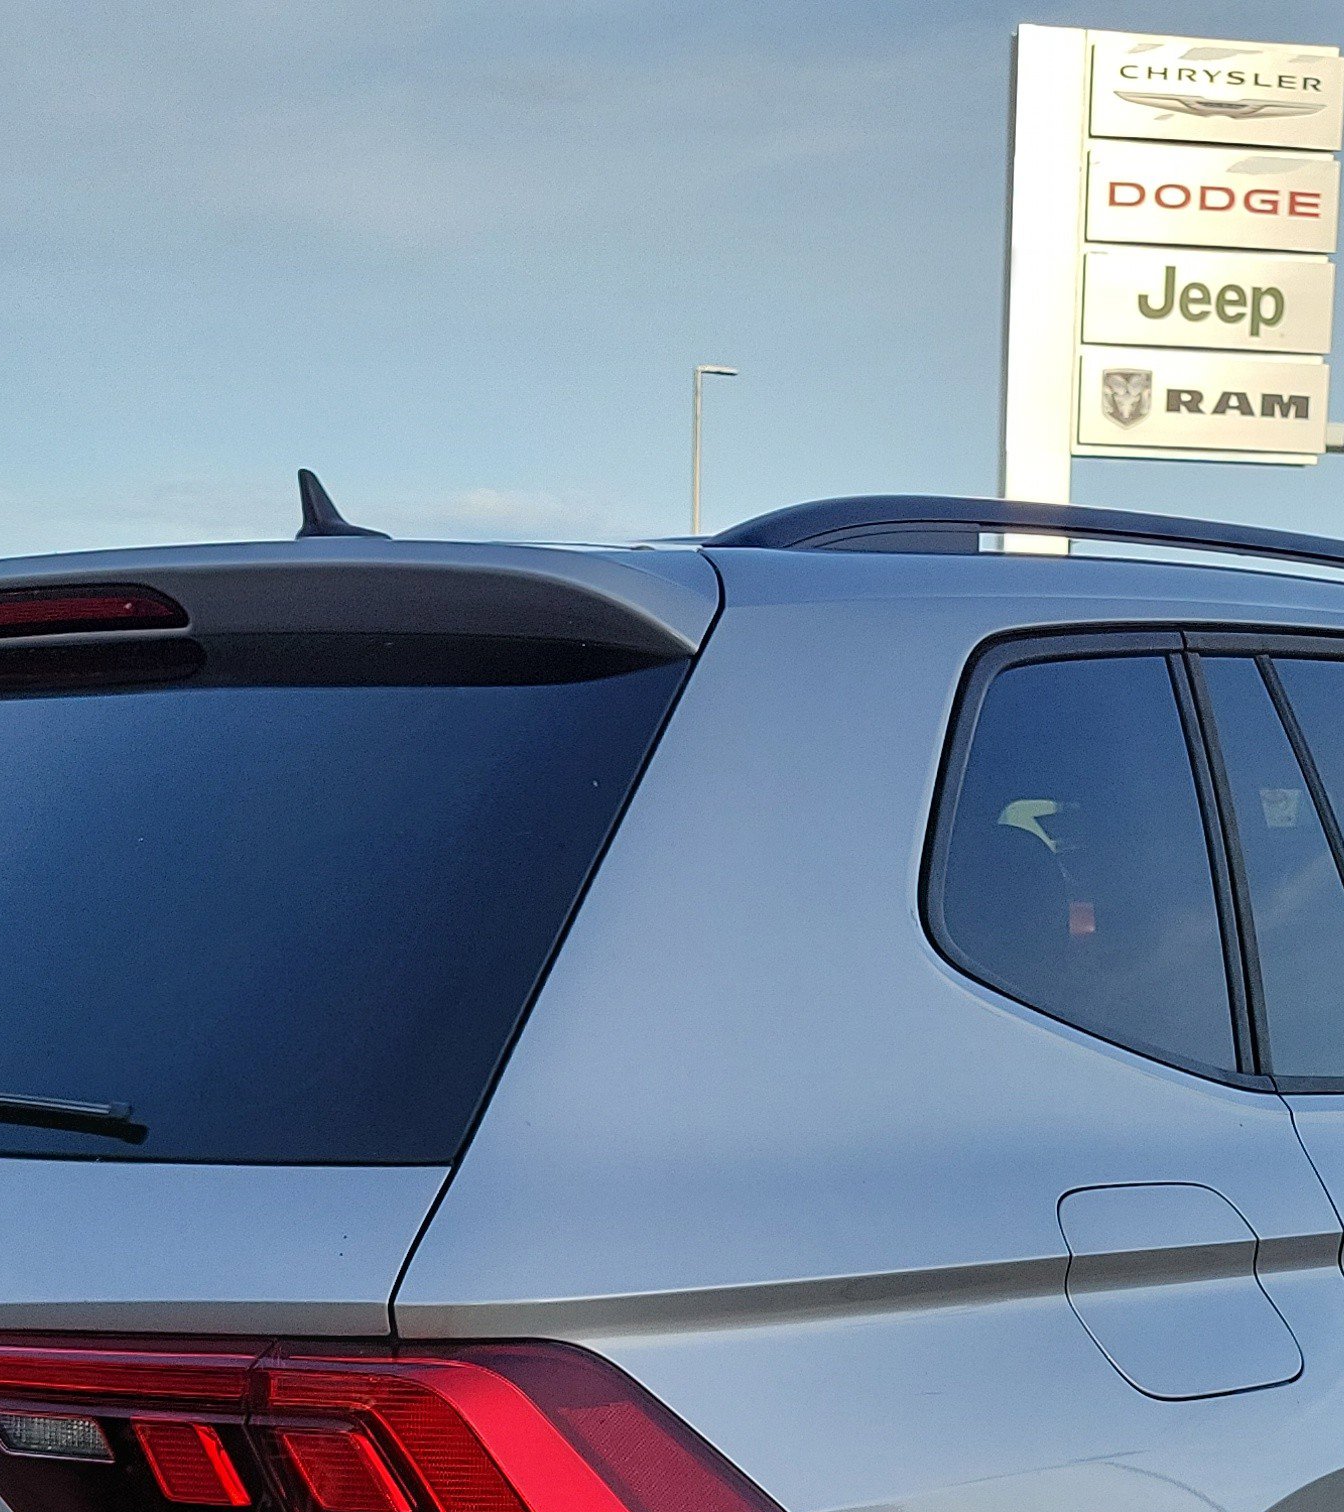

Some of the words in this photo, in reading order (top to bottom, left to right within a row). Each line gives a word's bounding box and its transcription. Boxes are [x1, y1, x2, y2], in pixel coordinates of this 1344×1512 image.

[1119, 64, 1323, 92] CHRYSLER
[1107, 181, 1322, 218] DODGE
[1137, 265, 1285, 337] Jeep
[1165, 388, 1310, 420] RAM
